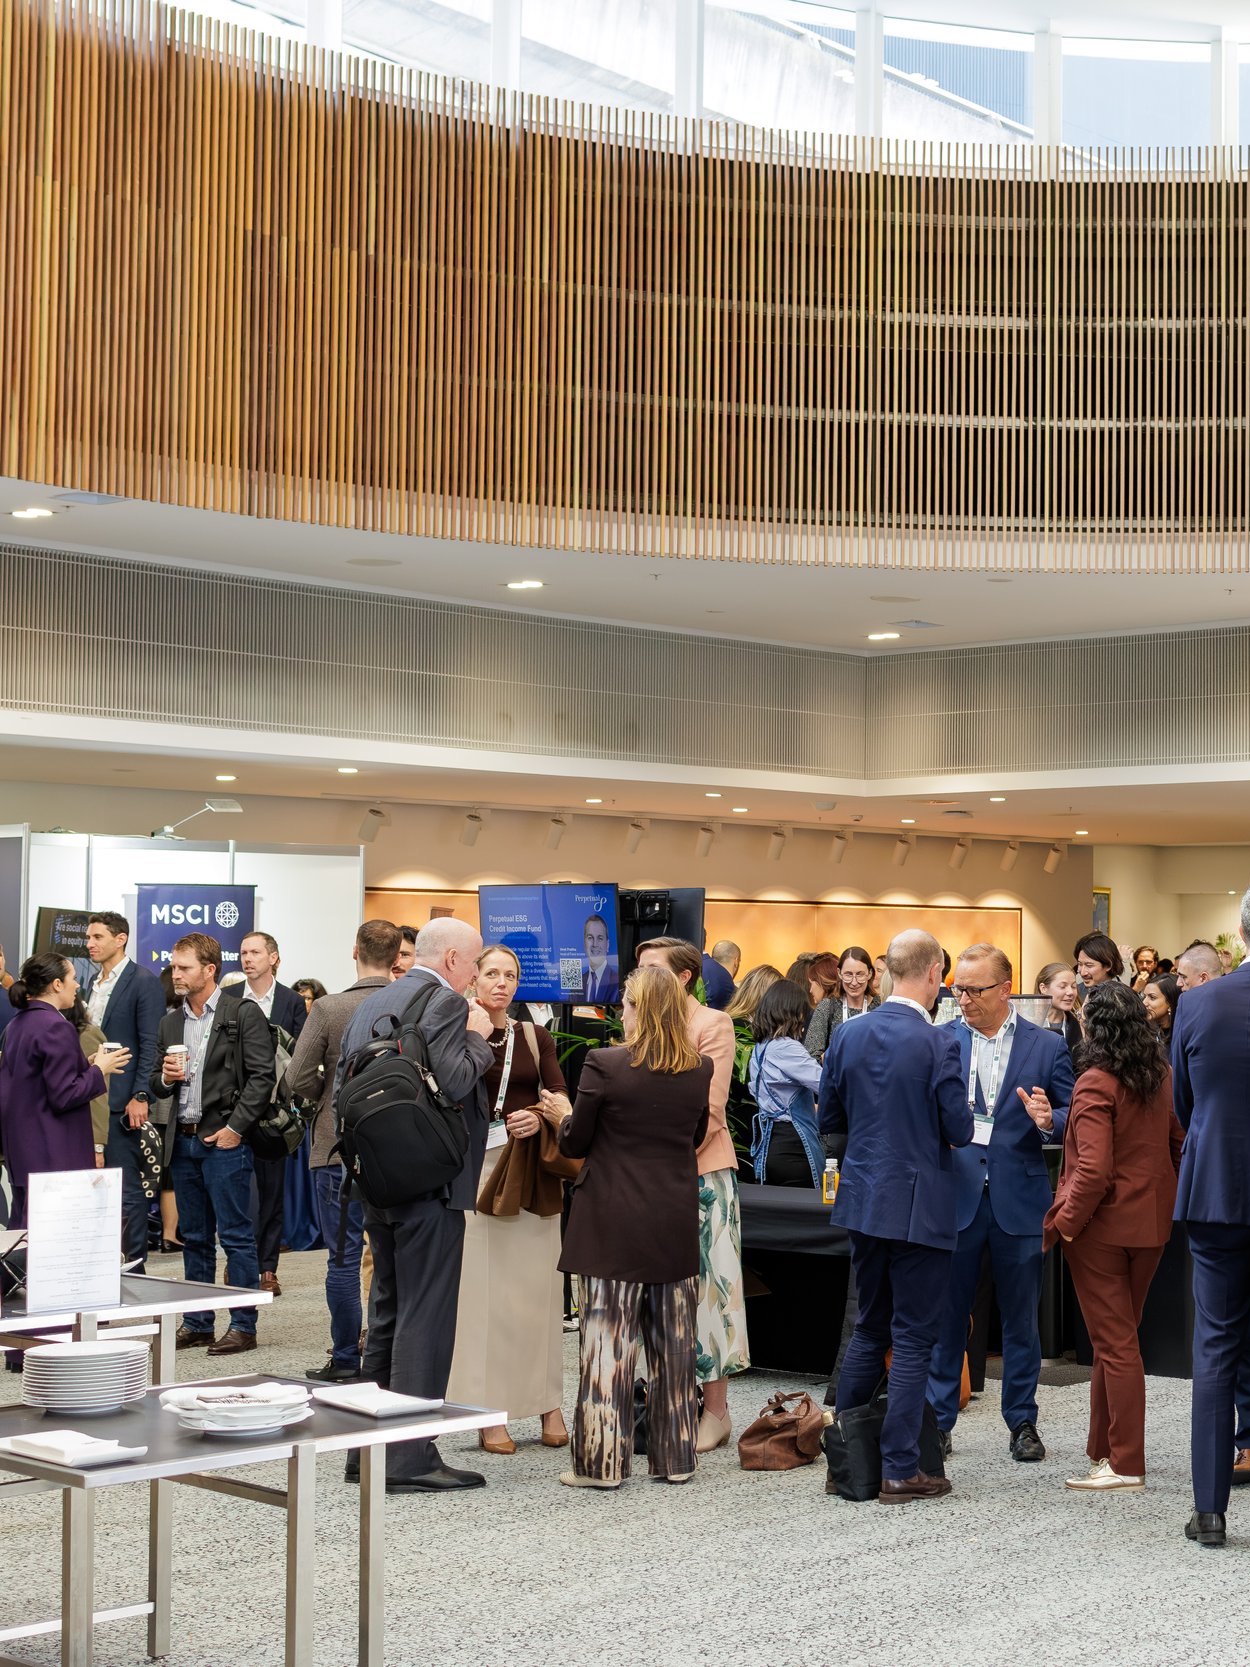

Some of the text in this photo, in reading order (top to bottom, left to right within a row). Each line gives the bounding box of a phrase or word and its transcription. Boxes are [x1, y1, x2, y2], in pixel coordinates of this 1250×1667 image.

[152, 904, 209, 925] MSCI
[489, 915, 514, 923] Perpetual
[66, 923, 81, 932] social
[62, 935, 66, 944] in
[68, 936, 83, 947] equity
[221, 951, 239, 961] tter
